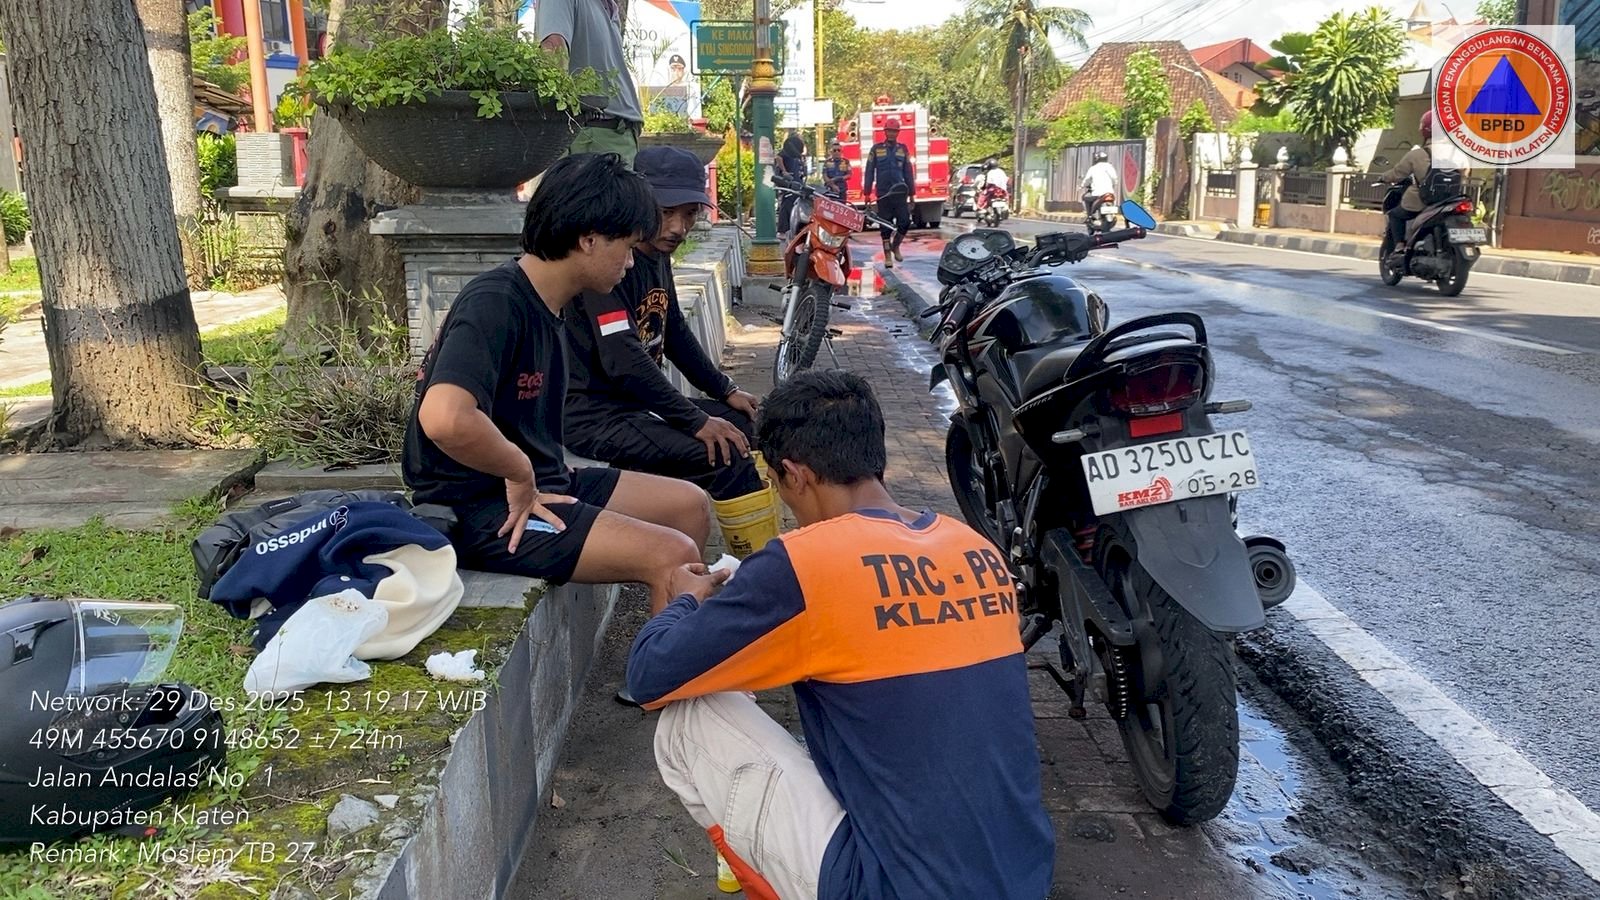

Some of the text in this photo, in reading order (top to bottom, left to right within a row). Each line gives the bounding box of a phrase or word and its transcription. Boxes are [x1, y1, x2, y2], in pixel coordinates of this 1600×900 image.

[712, 30, 755, 40] KE MAKA
[1087, 432, 1250, 482] AD 3250 CZC
[255, 518, 327, 555] indesso
[861, 554, 946, 598] TRC
[874, 592, 1014, 631] KLATEN
